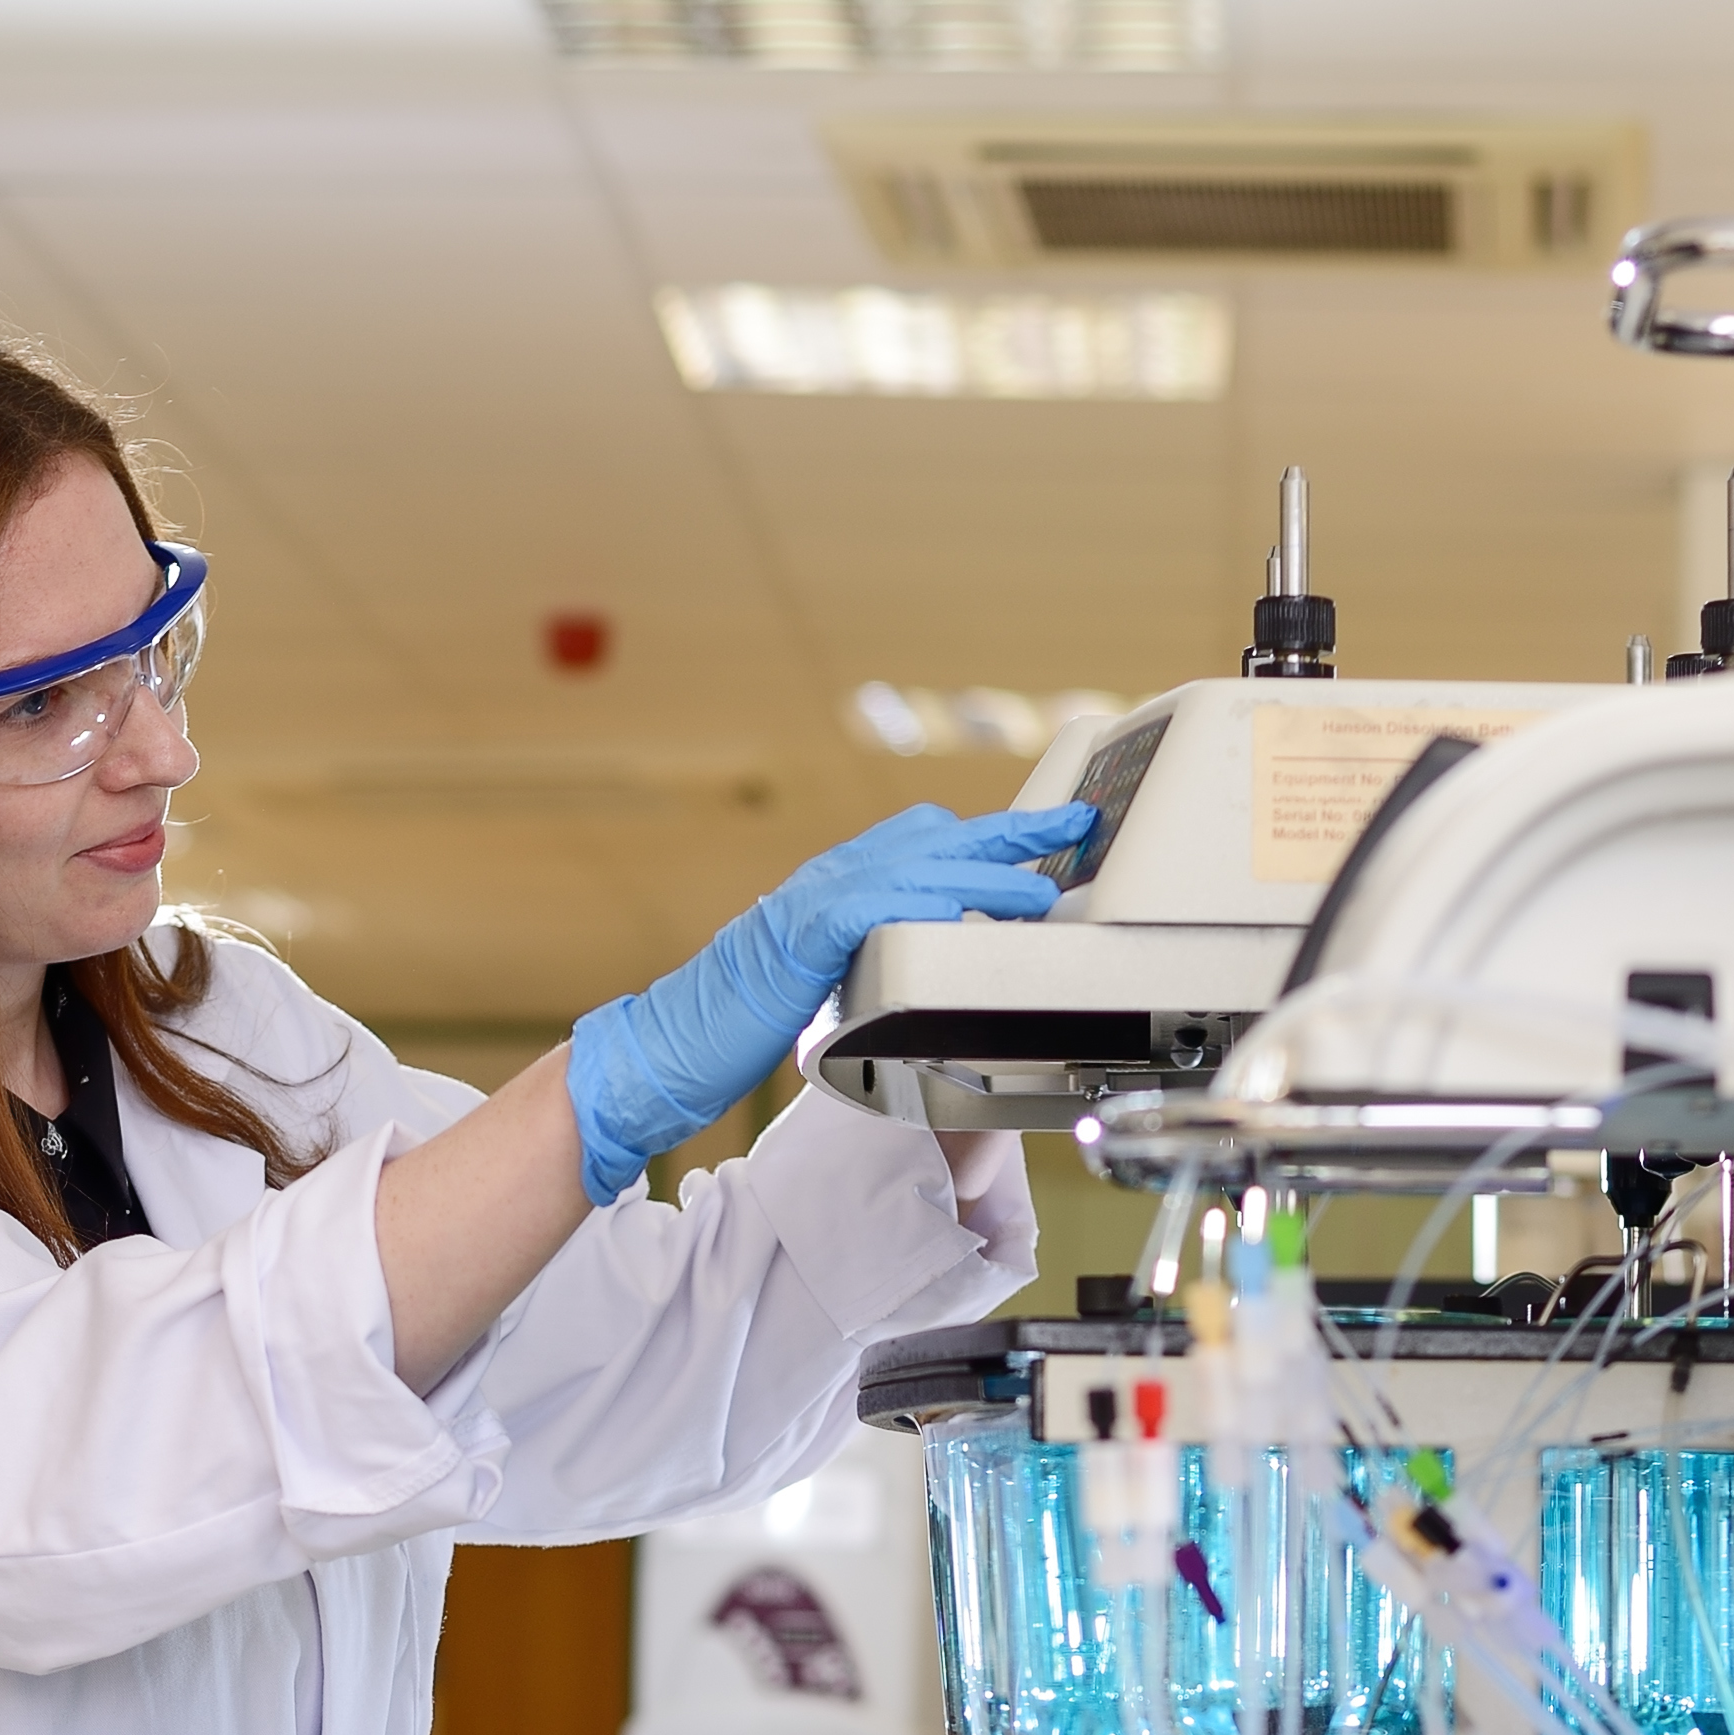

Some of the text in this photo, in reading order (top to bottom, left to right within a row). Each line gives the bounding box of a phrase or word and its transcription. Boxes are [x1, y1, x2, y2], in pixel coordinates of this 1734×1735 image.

[1322, 720, 1382, 735] Hanson
[1478, 723, 1513, 738] Bath
[1272, 772, 1356, 789] Equipment
[1272, 808, 1317, 822] Serial
[1272, 827, 1319, 840] Model
